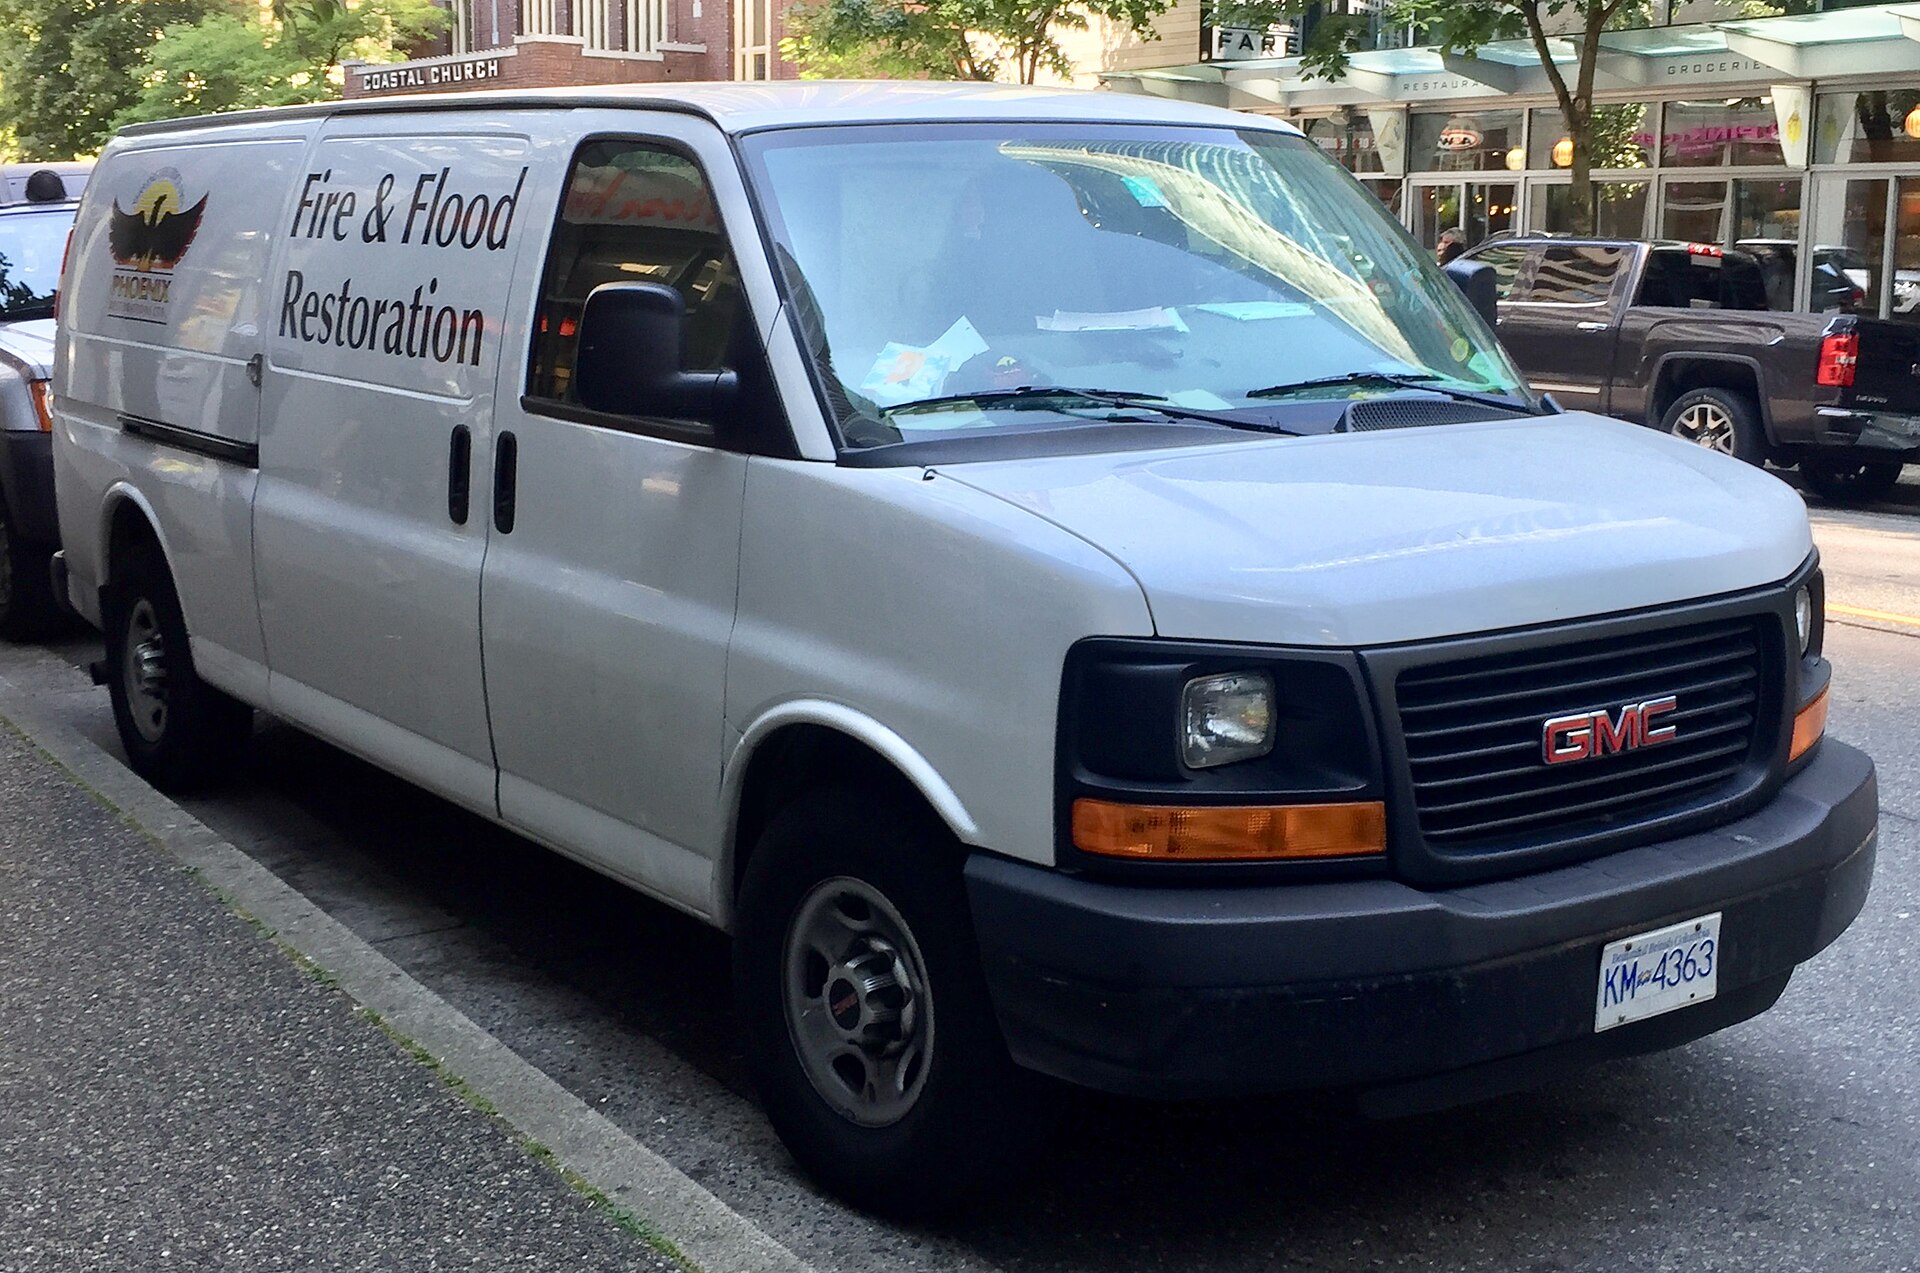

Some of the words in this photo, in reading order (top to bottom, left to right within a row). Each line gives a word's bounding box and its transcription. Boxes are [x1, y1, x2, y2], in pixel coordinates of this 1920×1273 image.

[1218, 30, 1299, 57] FARE
[362, 69, 425, 91] COASTAL
[430, 59, 499, 84] CHURCH
[1667, 61, 1771, 75] GROCERIE
[1403, 80, 1485, 91] RESTAUR
[290, 169, 357, 241] Fire
[361, 173, 395, 244] &
[401, 166, 529, 251] Flood
[111, 274, 172, 303] PHOENIX
[278, 269, 484, 366] Restoration
[1542, 695, 1677, 765] GMC
[1603, 960, 1638, 1008] KM
[1651, 939, 1715, 990] 4363
